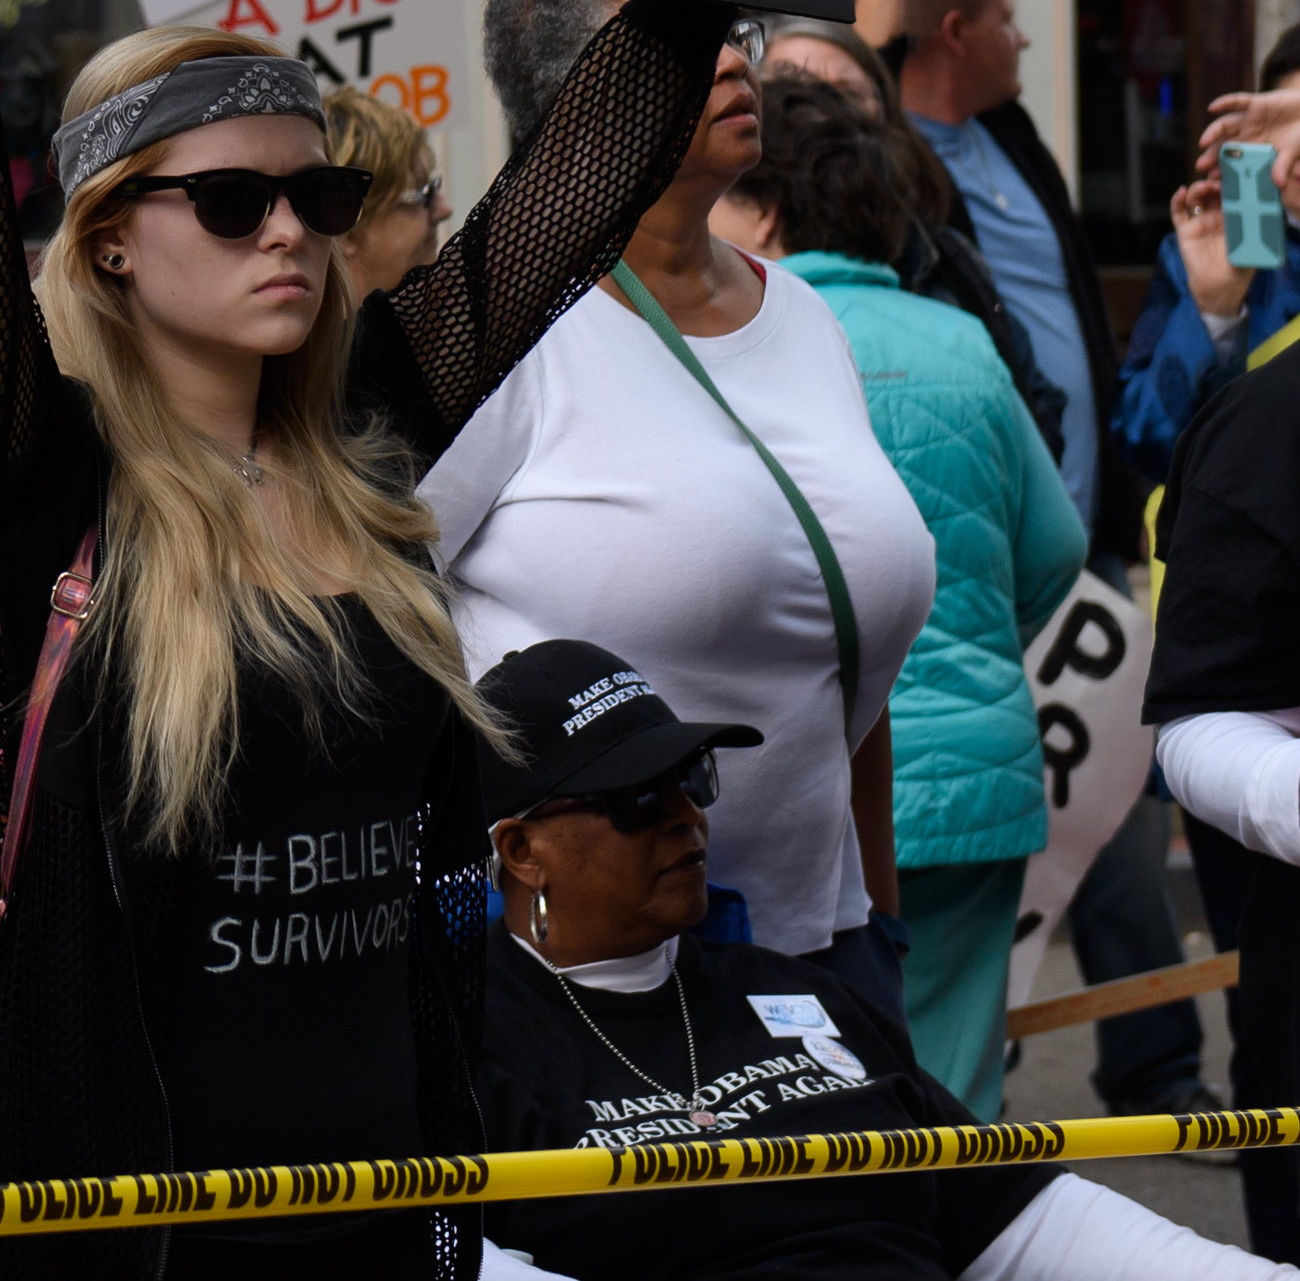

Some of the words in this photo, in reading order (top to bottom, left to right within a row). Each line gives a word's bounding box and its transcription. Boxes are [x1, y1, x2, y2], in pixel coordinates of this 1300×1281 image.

[299, 14, 394, 85] AT
[369, 64, 451, 128] OB
[561, 684, 643, 737] PRESIDENT
[567, 677, 615, 711] MAKE
[203, 892, 413, 974] SURVIVORS
[574, 1089, 771, 1149] RESIDNT
[585, 1092, 694, 1122] MAKE
[693, 1053, 821, 1107] OBAMA
